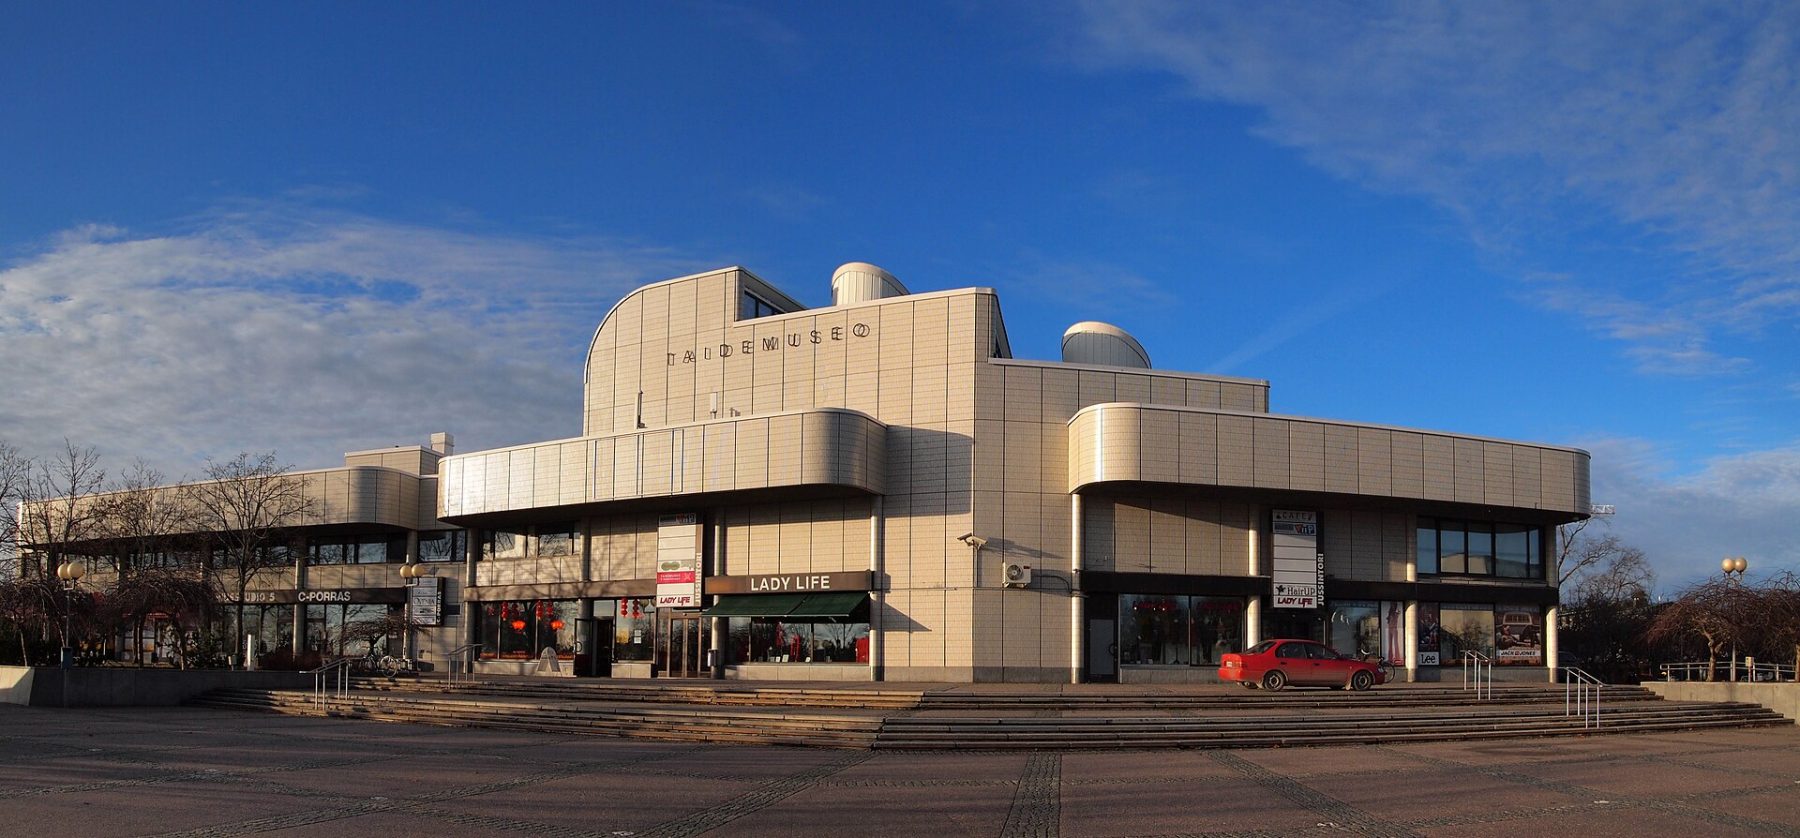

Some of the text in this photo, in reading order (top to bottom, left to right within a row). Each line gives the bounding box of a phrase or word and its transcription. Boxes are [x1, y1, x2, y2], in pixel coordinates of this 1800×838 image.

[668, 322, 870, 366] TAIDEMUSEO
[751, 575, 830, 591] LADY LIFE
[268, 592, 276, 602] 5
[298, 591, 351, 602] C-PORRAS
[677, 596, 691, 606] LIFE
[1277, 597, 1313, 608] LADY LIFE
[1421, 654, 1436, 664] Lee
